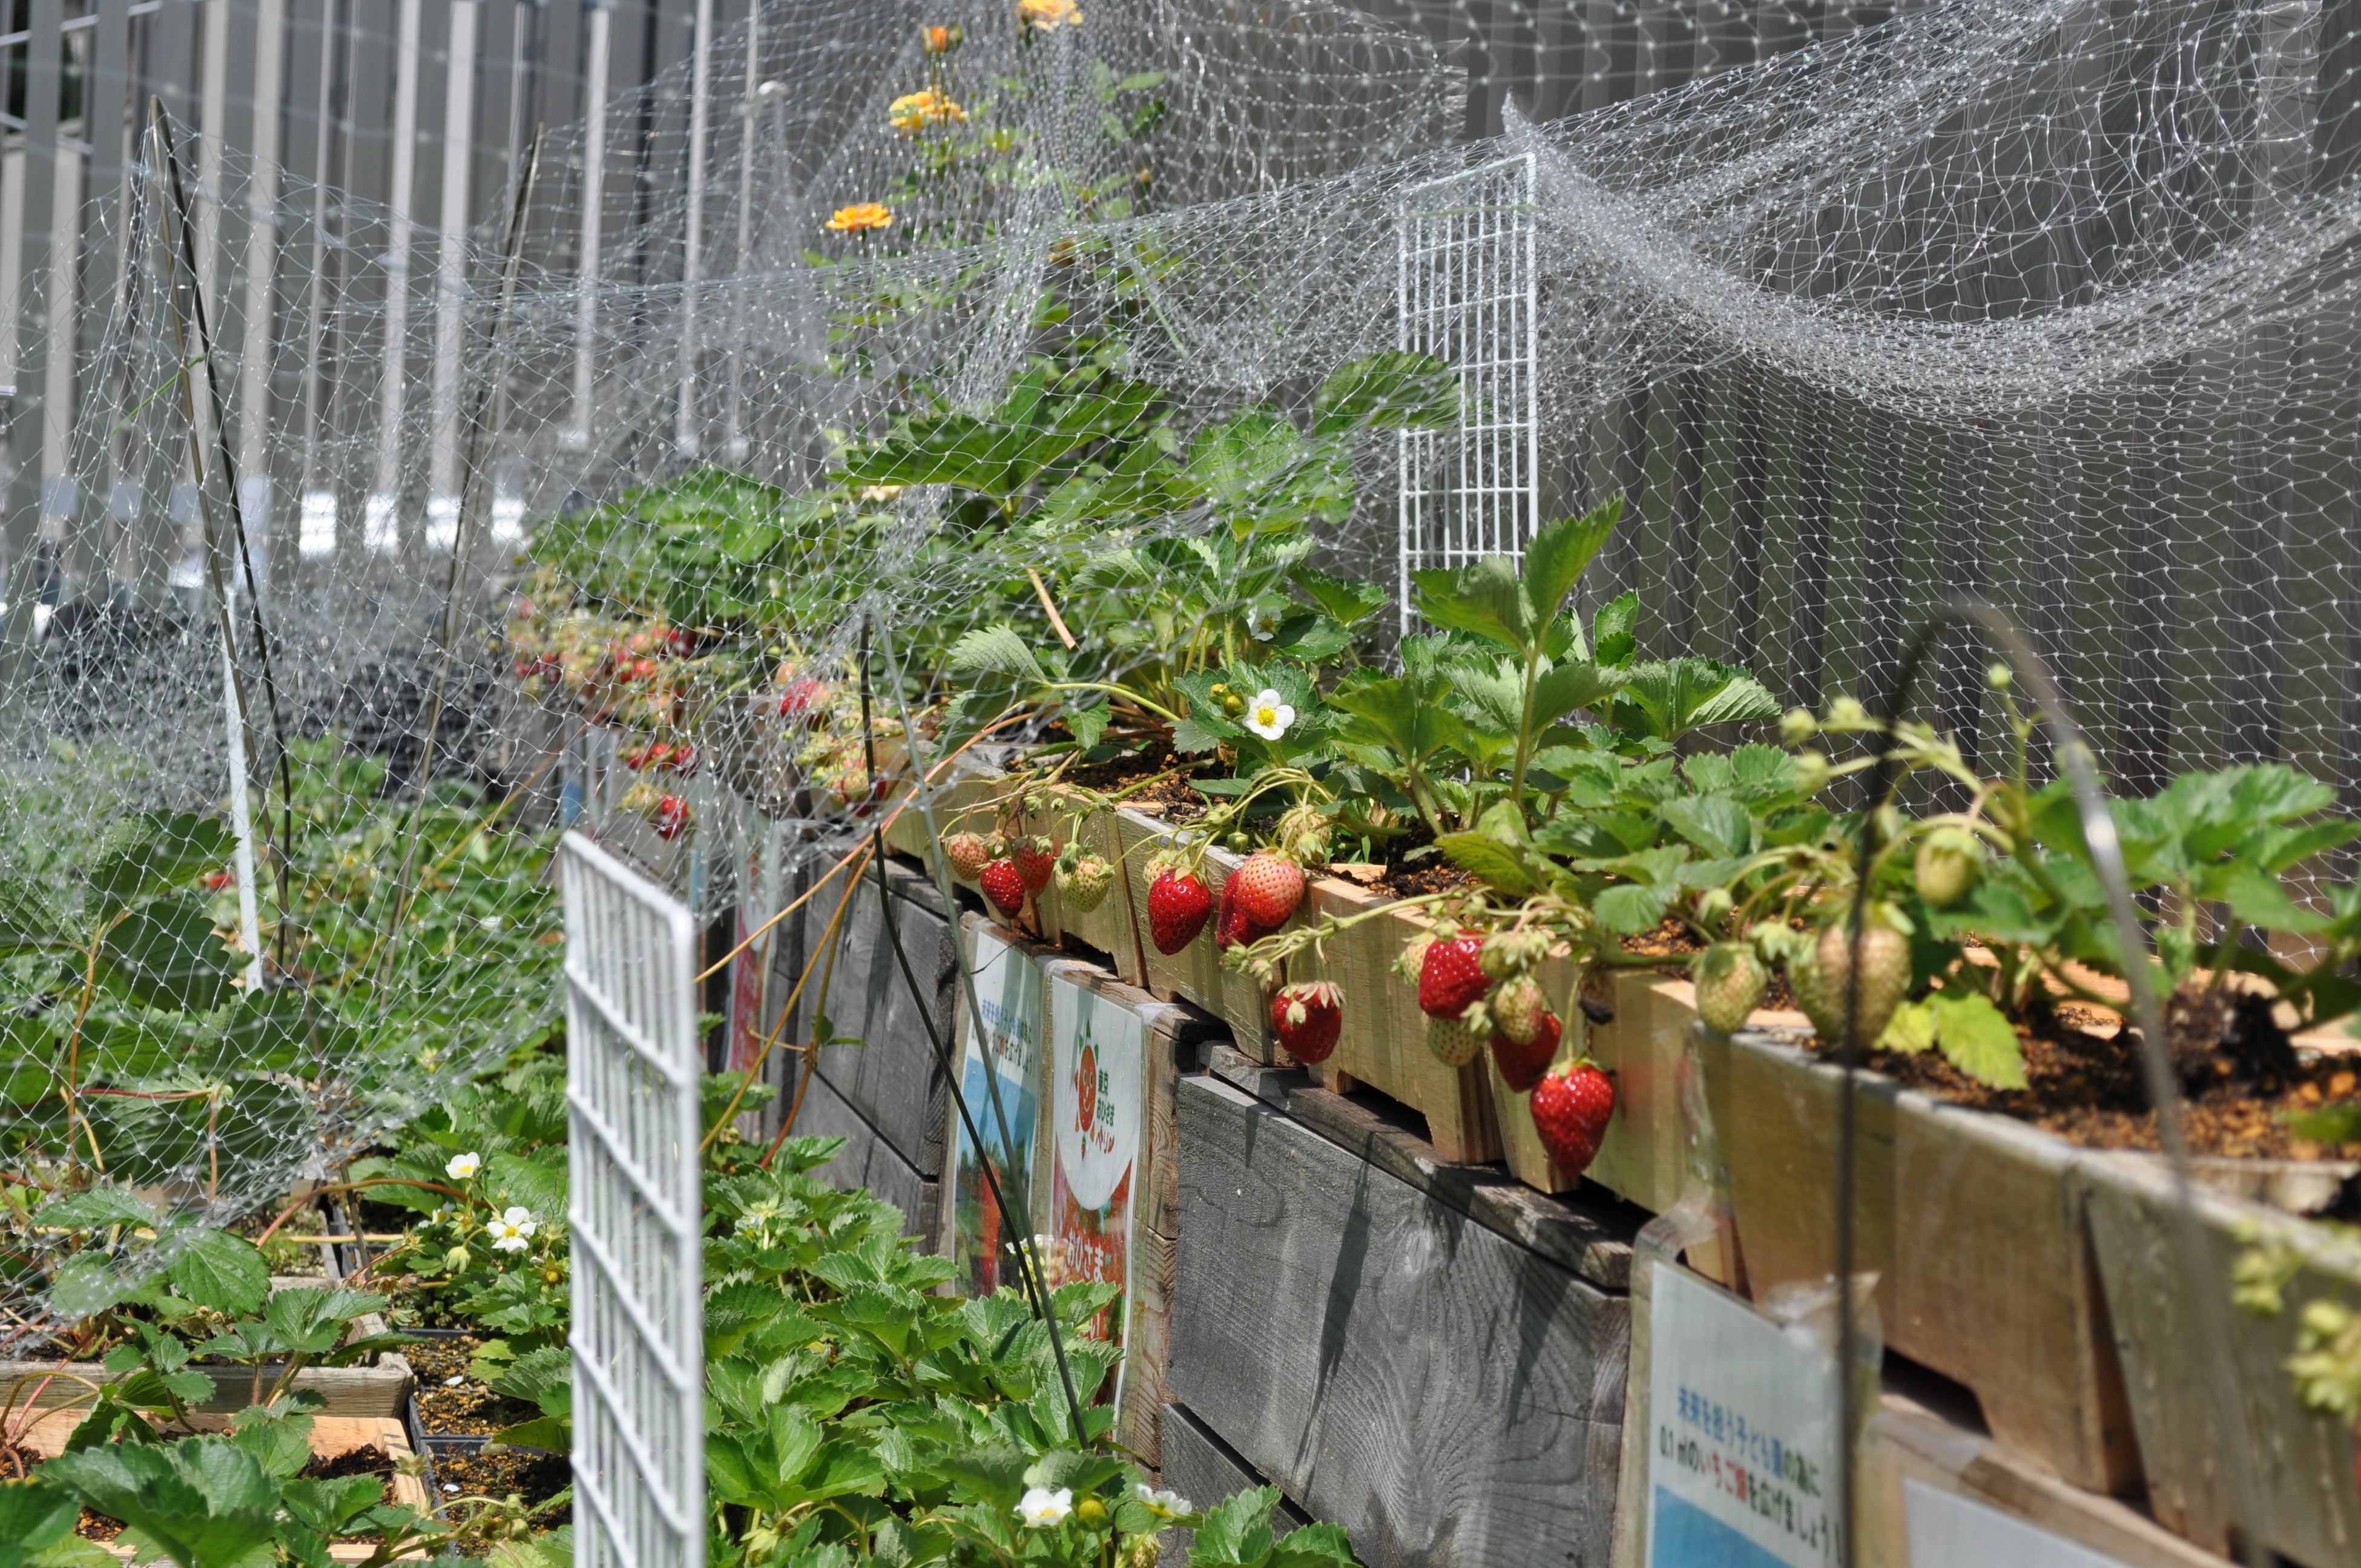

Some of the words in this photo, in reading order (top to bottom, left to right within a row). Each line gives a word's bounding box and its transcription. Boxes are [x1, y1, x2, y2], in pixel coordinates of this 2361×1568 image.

[1098, 1068, 1108, 1096] 東京
[1096, 1098, 1115, 1127] おひさま
[1067, 1227, 1104, 1283] おひさま
